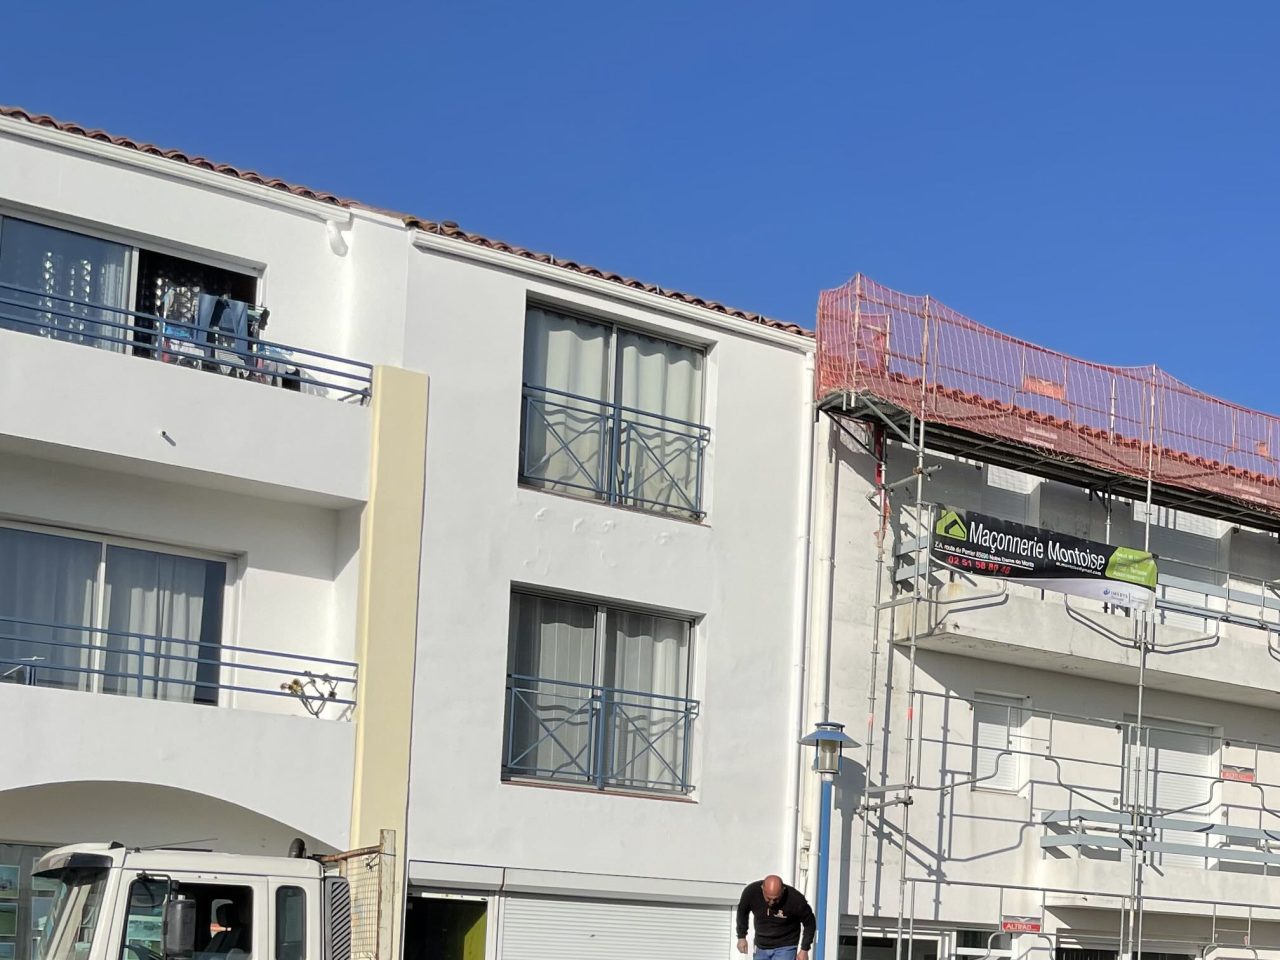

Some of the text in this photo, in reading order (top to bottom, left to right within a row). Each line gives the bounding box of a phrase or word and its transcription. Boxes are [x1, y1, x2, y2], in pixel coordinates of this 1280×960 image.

[947, 555, 960, 565] 02
[961, 558, 972, 568] 51
[969, 521, 1106, 571] Maçonnerie Montoise
